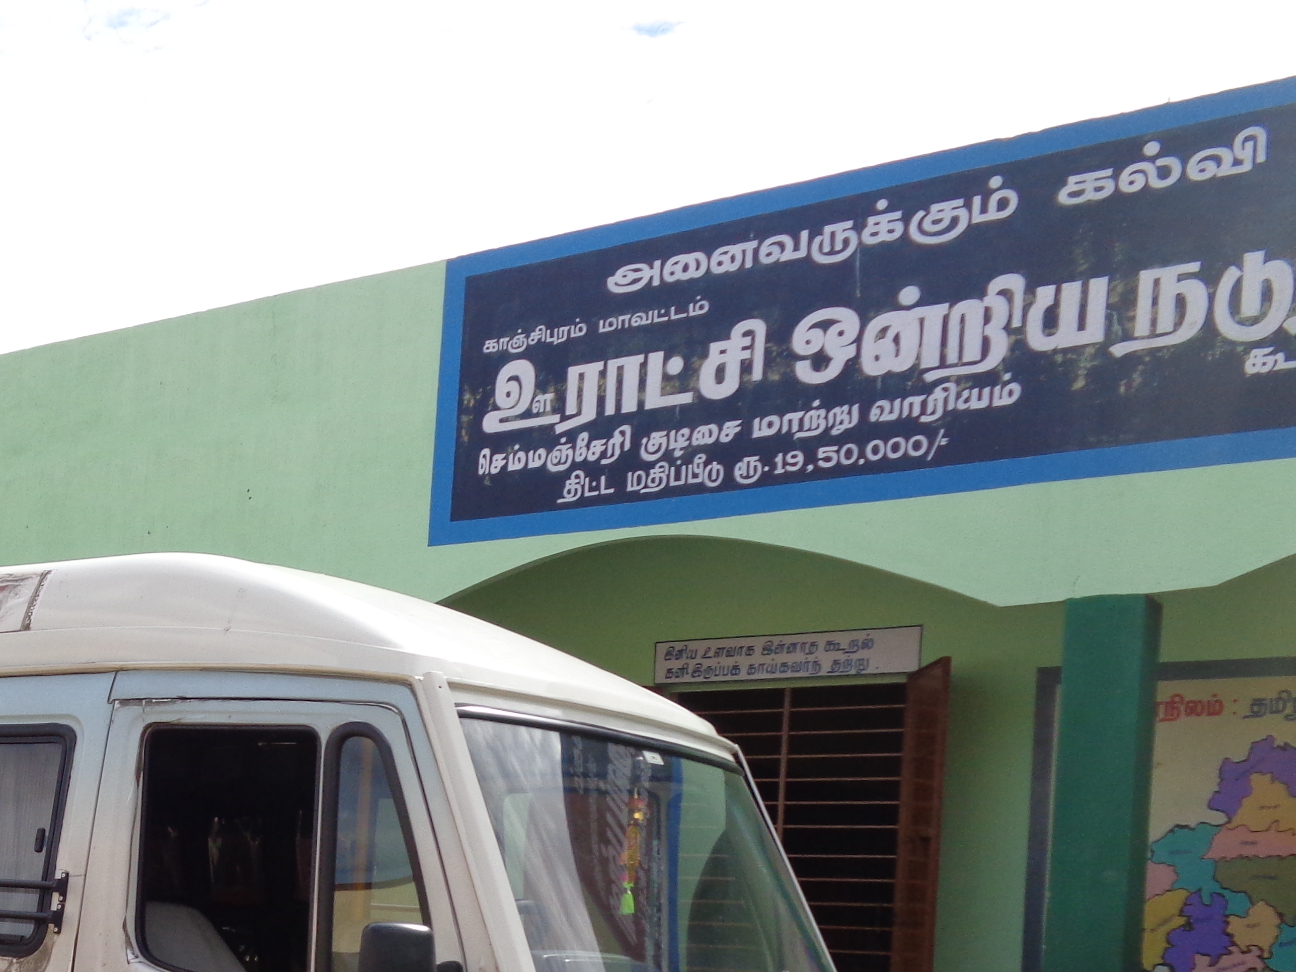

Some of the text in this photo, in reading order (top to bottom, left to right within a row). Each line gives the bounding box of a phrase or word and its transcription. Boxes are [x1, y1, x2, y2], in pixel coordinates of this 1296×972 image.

[606, 125, 1268, 293] அனைவருக்கும் கல்வி
[482, 250, 1296, 434] ஊராட்சி ஒன்றிய நடு
[483, 295, 710, 353] காஞ்சிபுரம் மாவட்டம்
[478, 373, 1022, 475] செம்மஞ்சேரி குடிசை மாற்று வாரியம்
[557, 470, 615, 503] திட்ட
[627, 453, 724, 493] மதிப்பீடு
